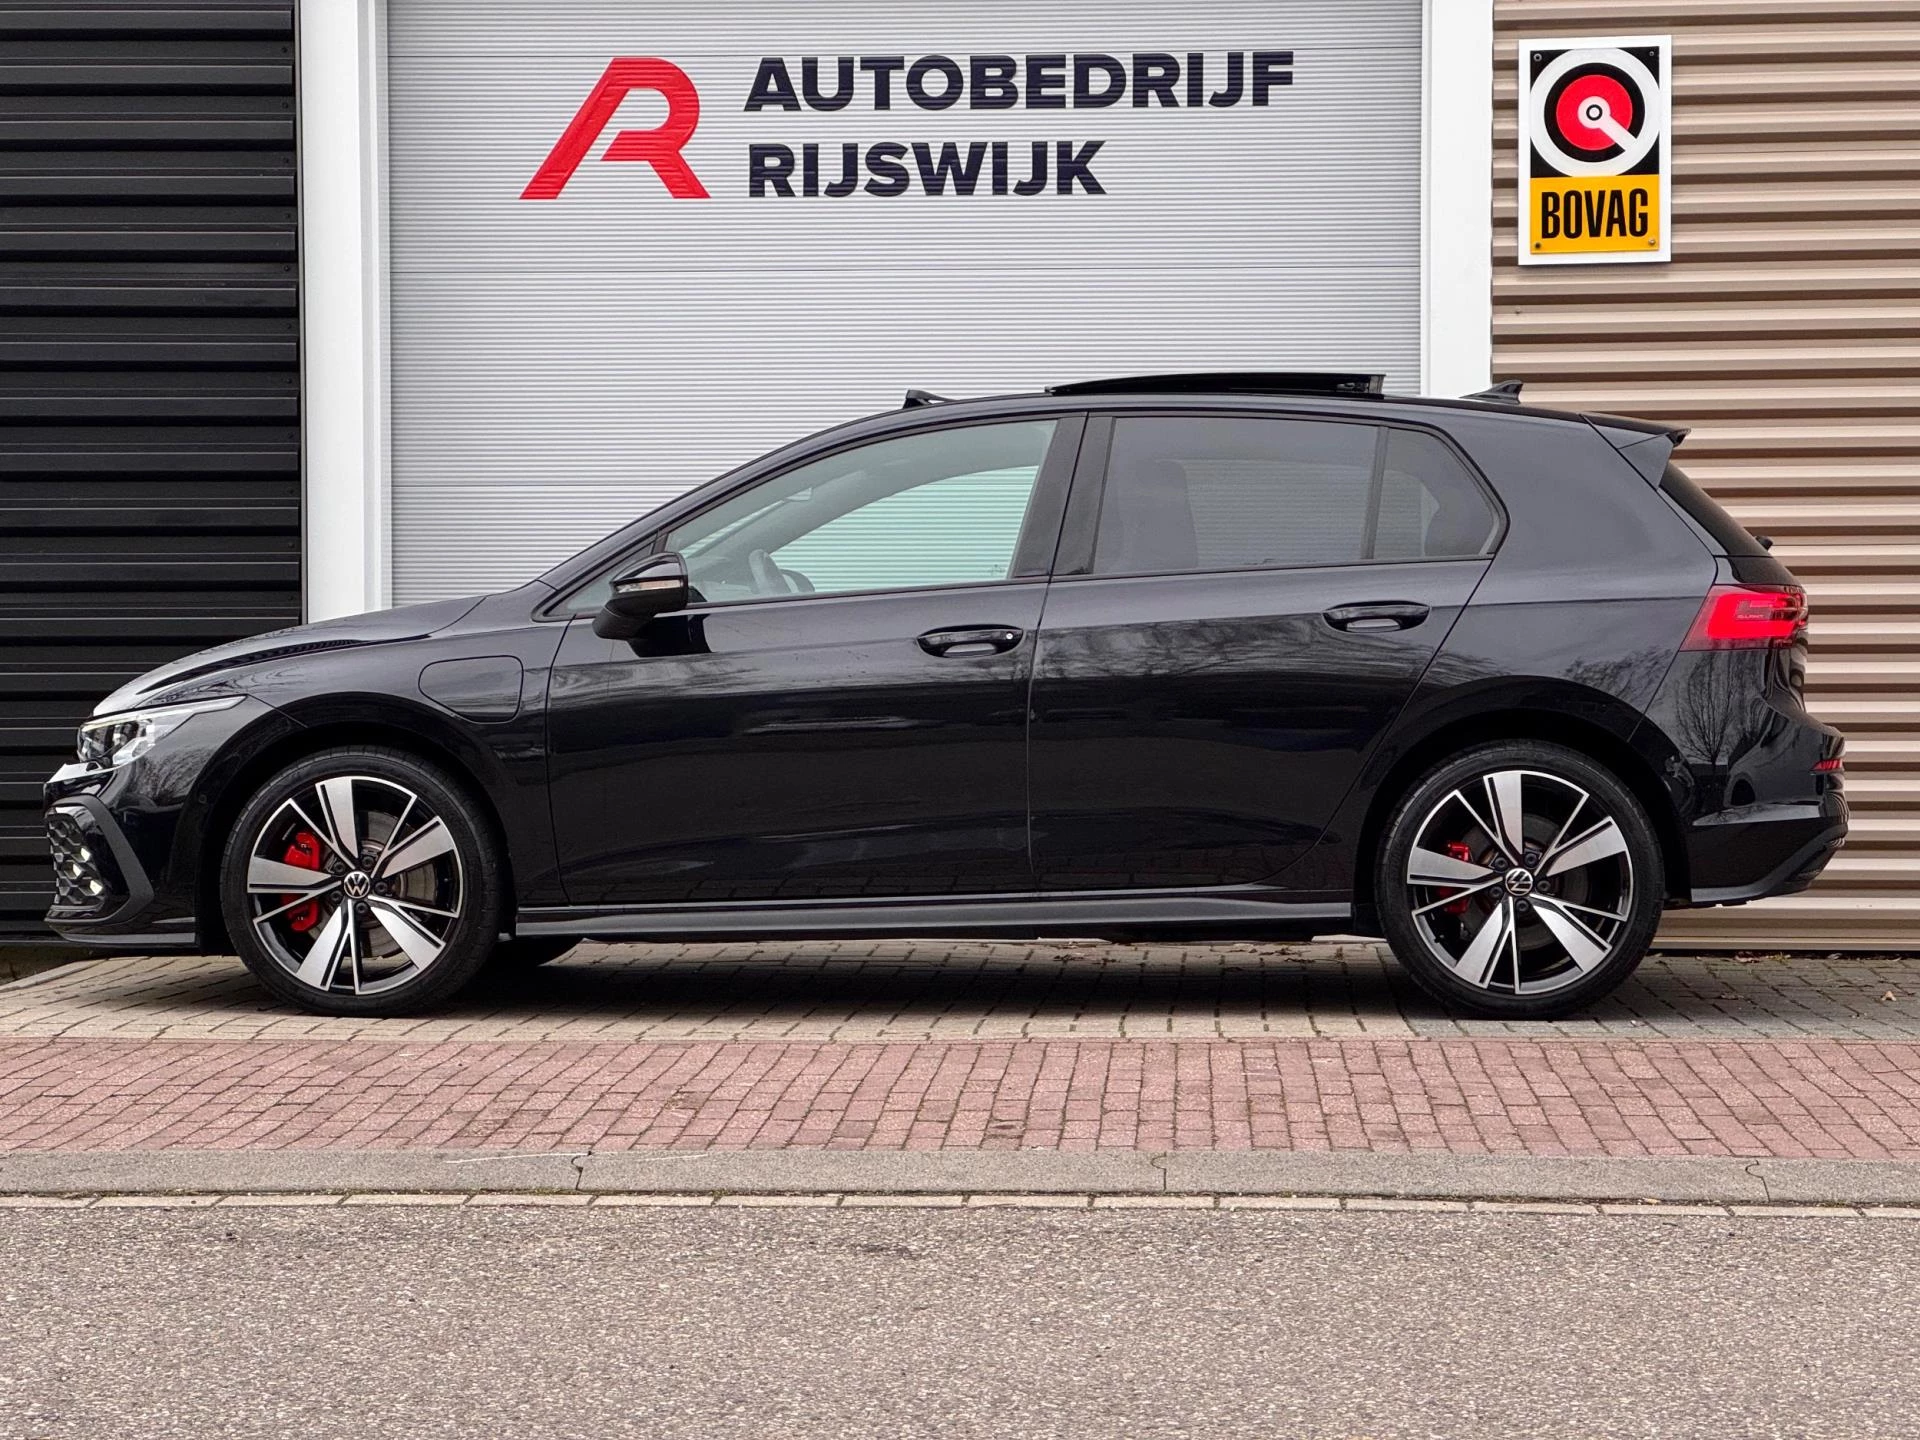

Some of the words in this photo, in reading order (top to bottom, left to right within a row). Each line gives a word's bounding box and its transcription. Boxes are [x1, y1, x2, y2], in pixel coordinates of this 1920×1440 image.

[744, 50, 1294, 111] AUTOBEDRIJF
[749, 141, 1106, 197] RIJSWIJK
[1541, 188, 1648, 239] BOVAG
